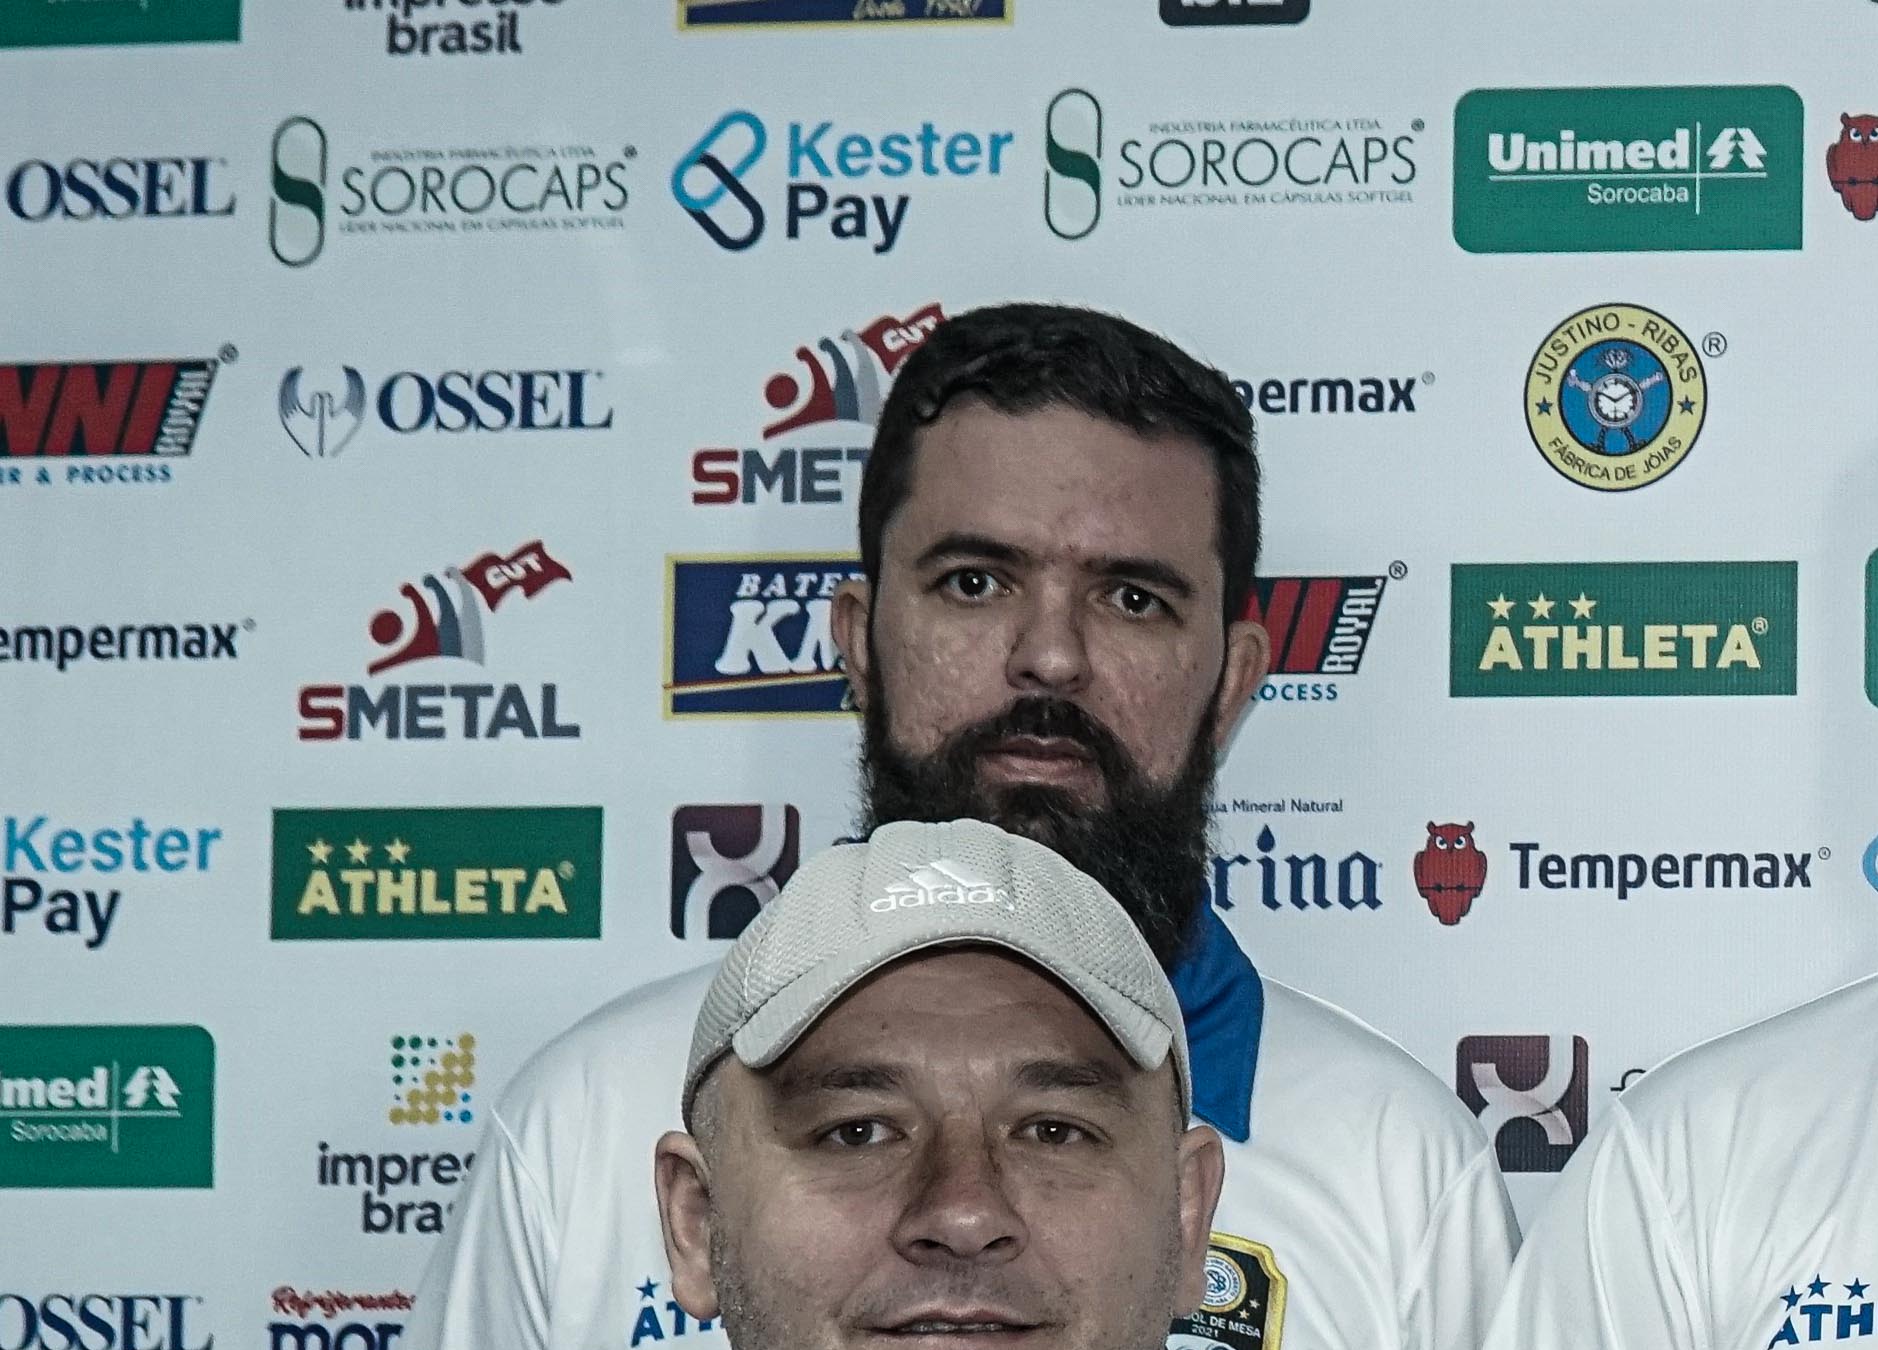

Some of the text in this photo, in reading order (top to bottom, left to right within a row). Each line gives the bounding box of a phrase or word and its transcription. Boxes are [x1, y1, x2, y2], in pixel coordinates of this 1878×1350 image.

[386, 13, 523, 55] brasil
[787, 122, 1013, 179] Kester
[1118, 134, 1417, 188] SOROCAPS
[1488, 129, 1691, 173] Unimed
[7, 157, 236, 221] OSSEL
[340, 161, 628, 217] SOROCAPS
[1587, 182, 1690, 205] Sorocaba
[785, 184, 909, 254] Pay
[1536, 312, 1620, 385] JUSTINO
[1641, 318, 1698, 384] RIBAS
[377, 370, 614, 432] OSSEL
[66, 463, 172, 484] PROCESS
[1614, 464, 1636, 481] DE
[0, 622, 238, 672] empermax
[1321, 578, 1383, 674] ROYAL
[1479, 623, 1762, 671] ATHLETA
[298, 683, 581, 742] SMETAL
[1252, 683, 1338, 701] OCESS
[1233, 798, 1286, 814] Mineral
[1291, 798, 1344, 813] Natural
[3, 815, 222, 873] Kester
[1211, 823, 1384, 912] rina
[1509, 842, 1812, 900] Tempermax
[2, 879, 119, 948] Pay
[298, 866, 568, 915] ATHLETA
[1, 1075, 108, 1110] med
[318, 1142, 476, 1197] impre
